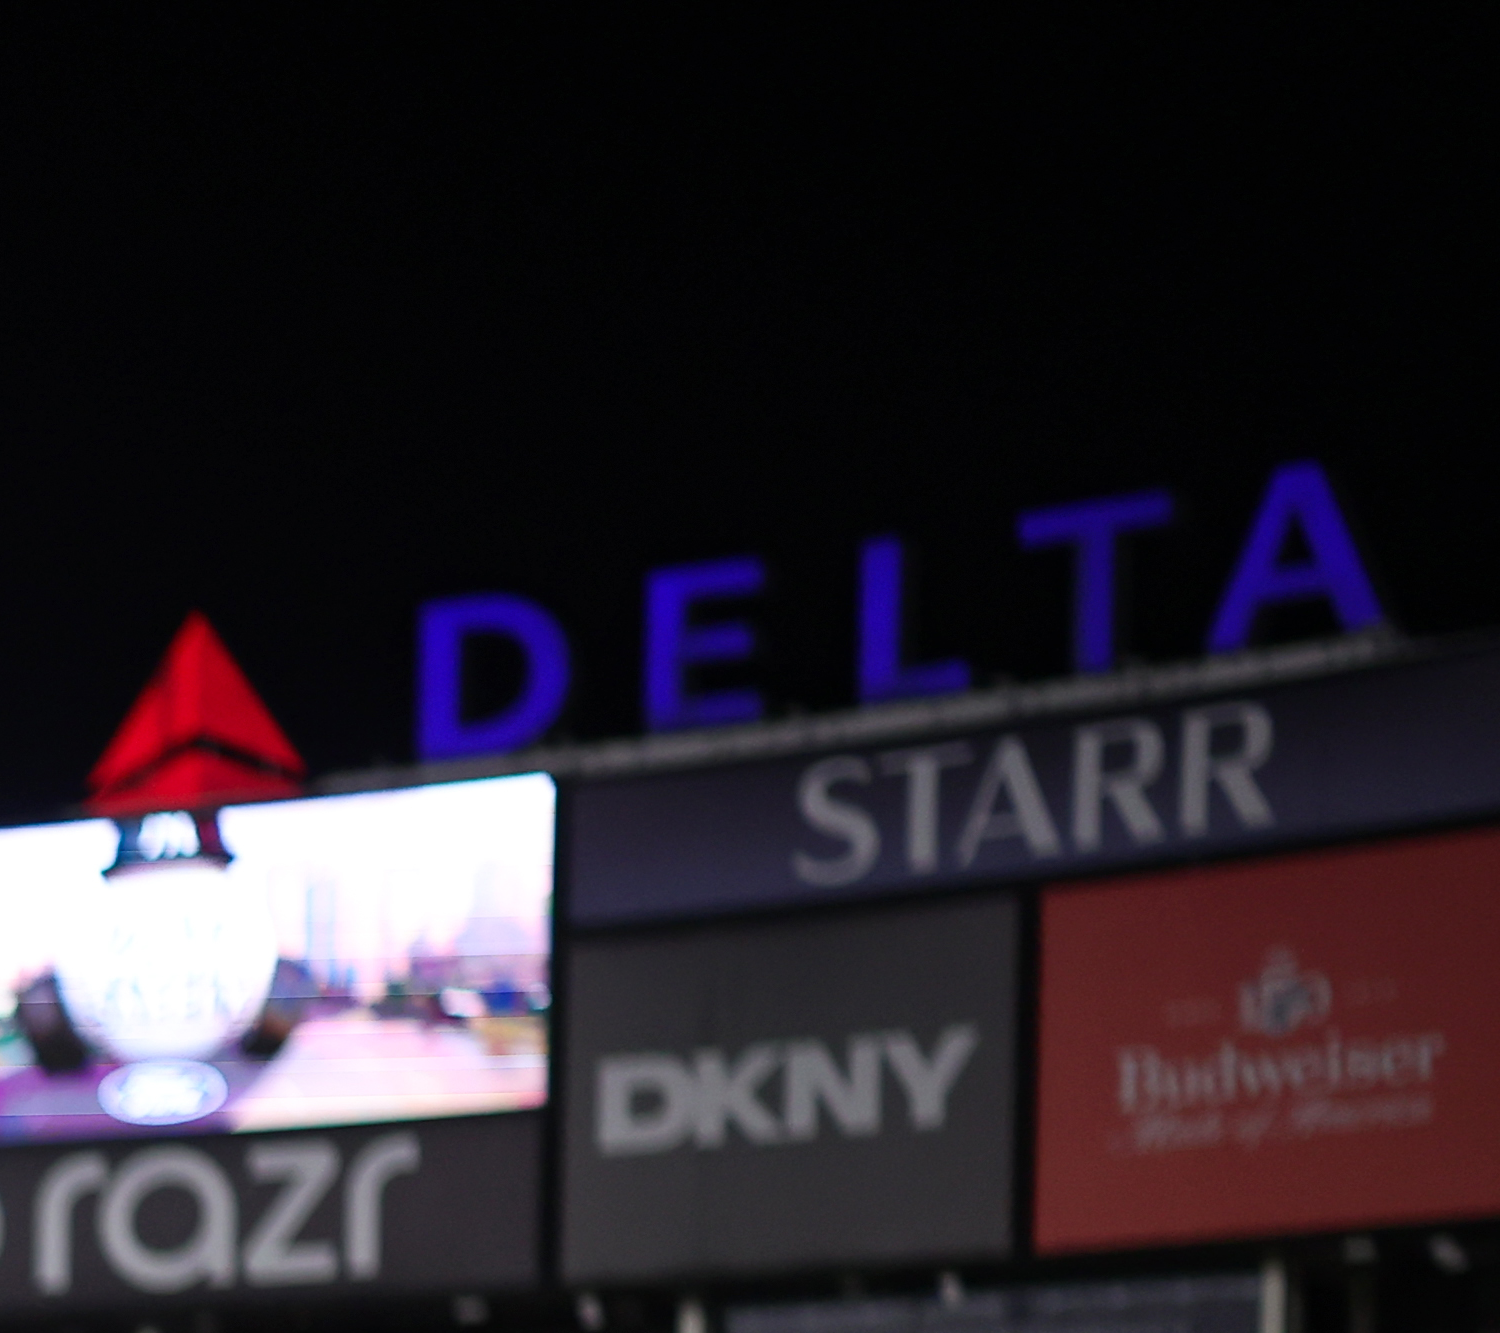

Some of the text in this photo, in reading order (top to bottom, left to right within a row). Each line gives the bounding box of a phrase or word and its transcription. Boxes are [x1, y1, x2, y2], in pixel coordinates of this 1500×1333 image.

[414, 460, 1388, 765] DELTA
[791, 697, 1276, 888] STARR
[592, 1022, 979, 1159] DKNY
[1116, 1031, 1447, 1116] Budweiser
[31, 1132, 422, 1296] razr
